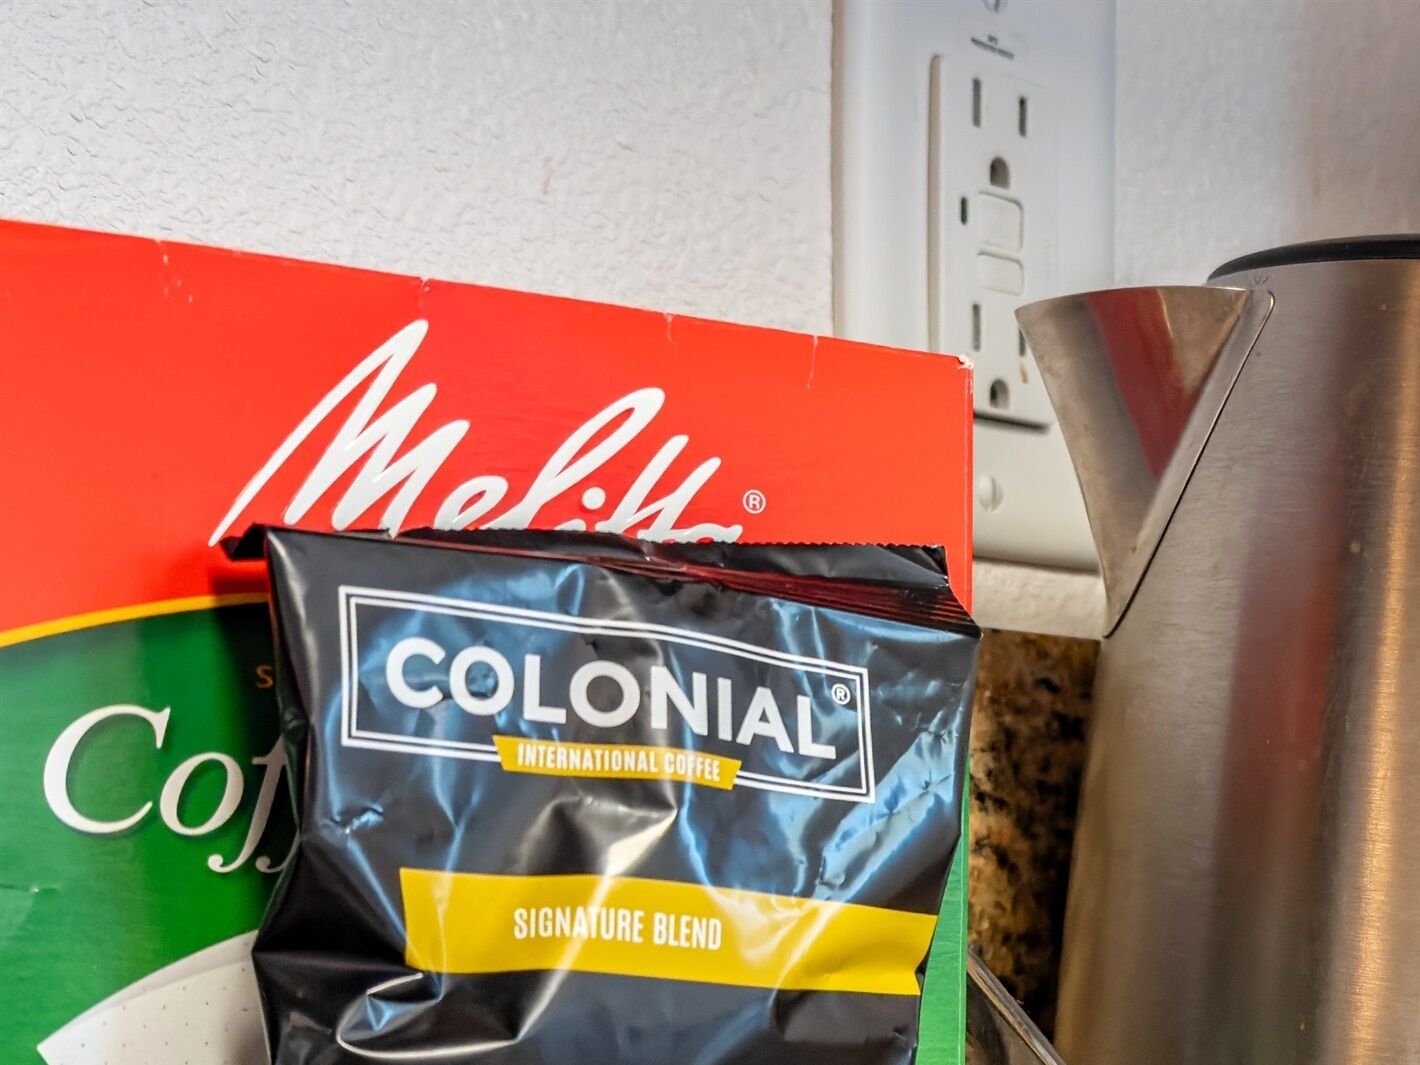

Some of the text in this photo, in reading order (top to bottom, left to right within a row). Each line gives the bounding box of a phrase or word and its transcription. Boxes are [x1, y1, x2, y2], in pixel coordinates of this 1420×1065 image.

[208, 319, 743, 547] Melitt
[386, 637, 837, 759] COLONIAL
[517, 743, 721, 782] INTERNATIONAL COFFEE
[513, 907, 722, 951] SIGNATURE BLEND
